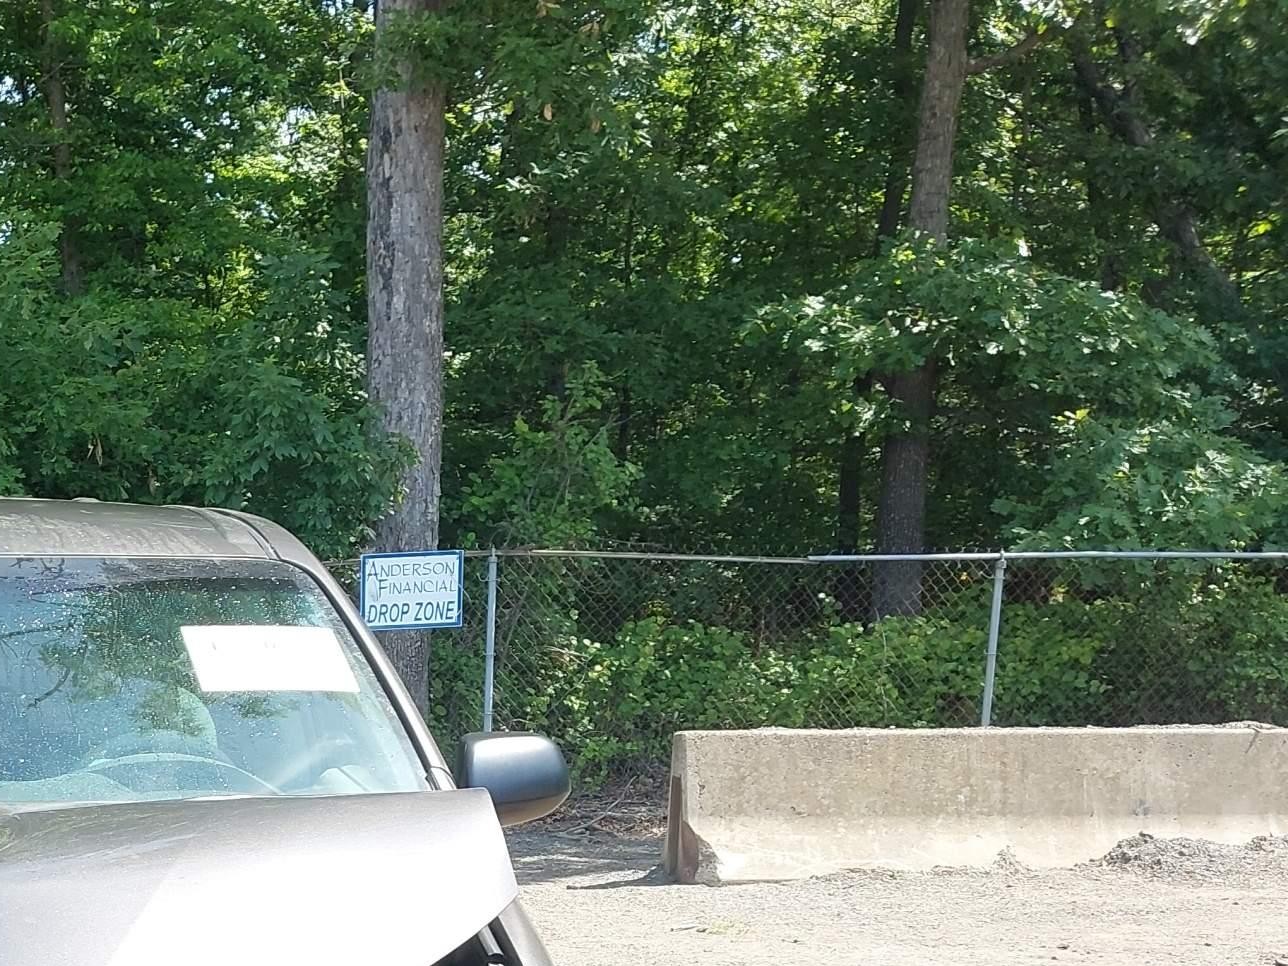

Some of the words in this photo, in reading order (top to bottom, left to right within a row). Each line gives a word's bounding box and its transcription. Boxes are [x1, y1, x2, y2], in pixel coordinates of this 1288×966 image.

[367, 561, 455, 581] ANDERSON
[377, 579, 457, 600] FINANCIAL
[367, 602, 410, 623] DROP
[414, 600, 456, 621] ZONE
